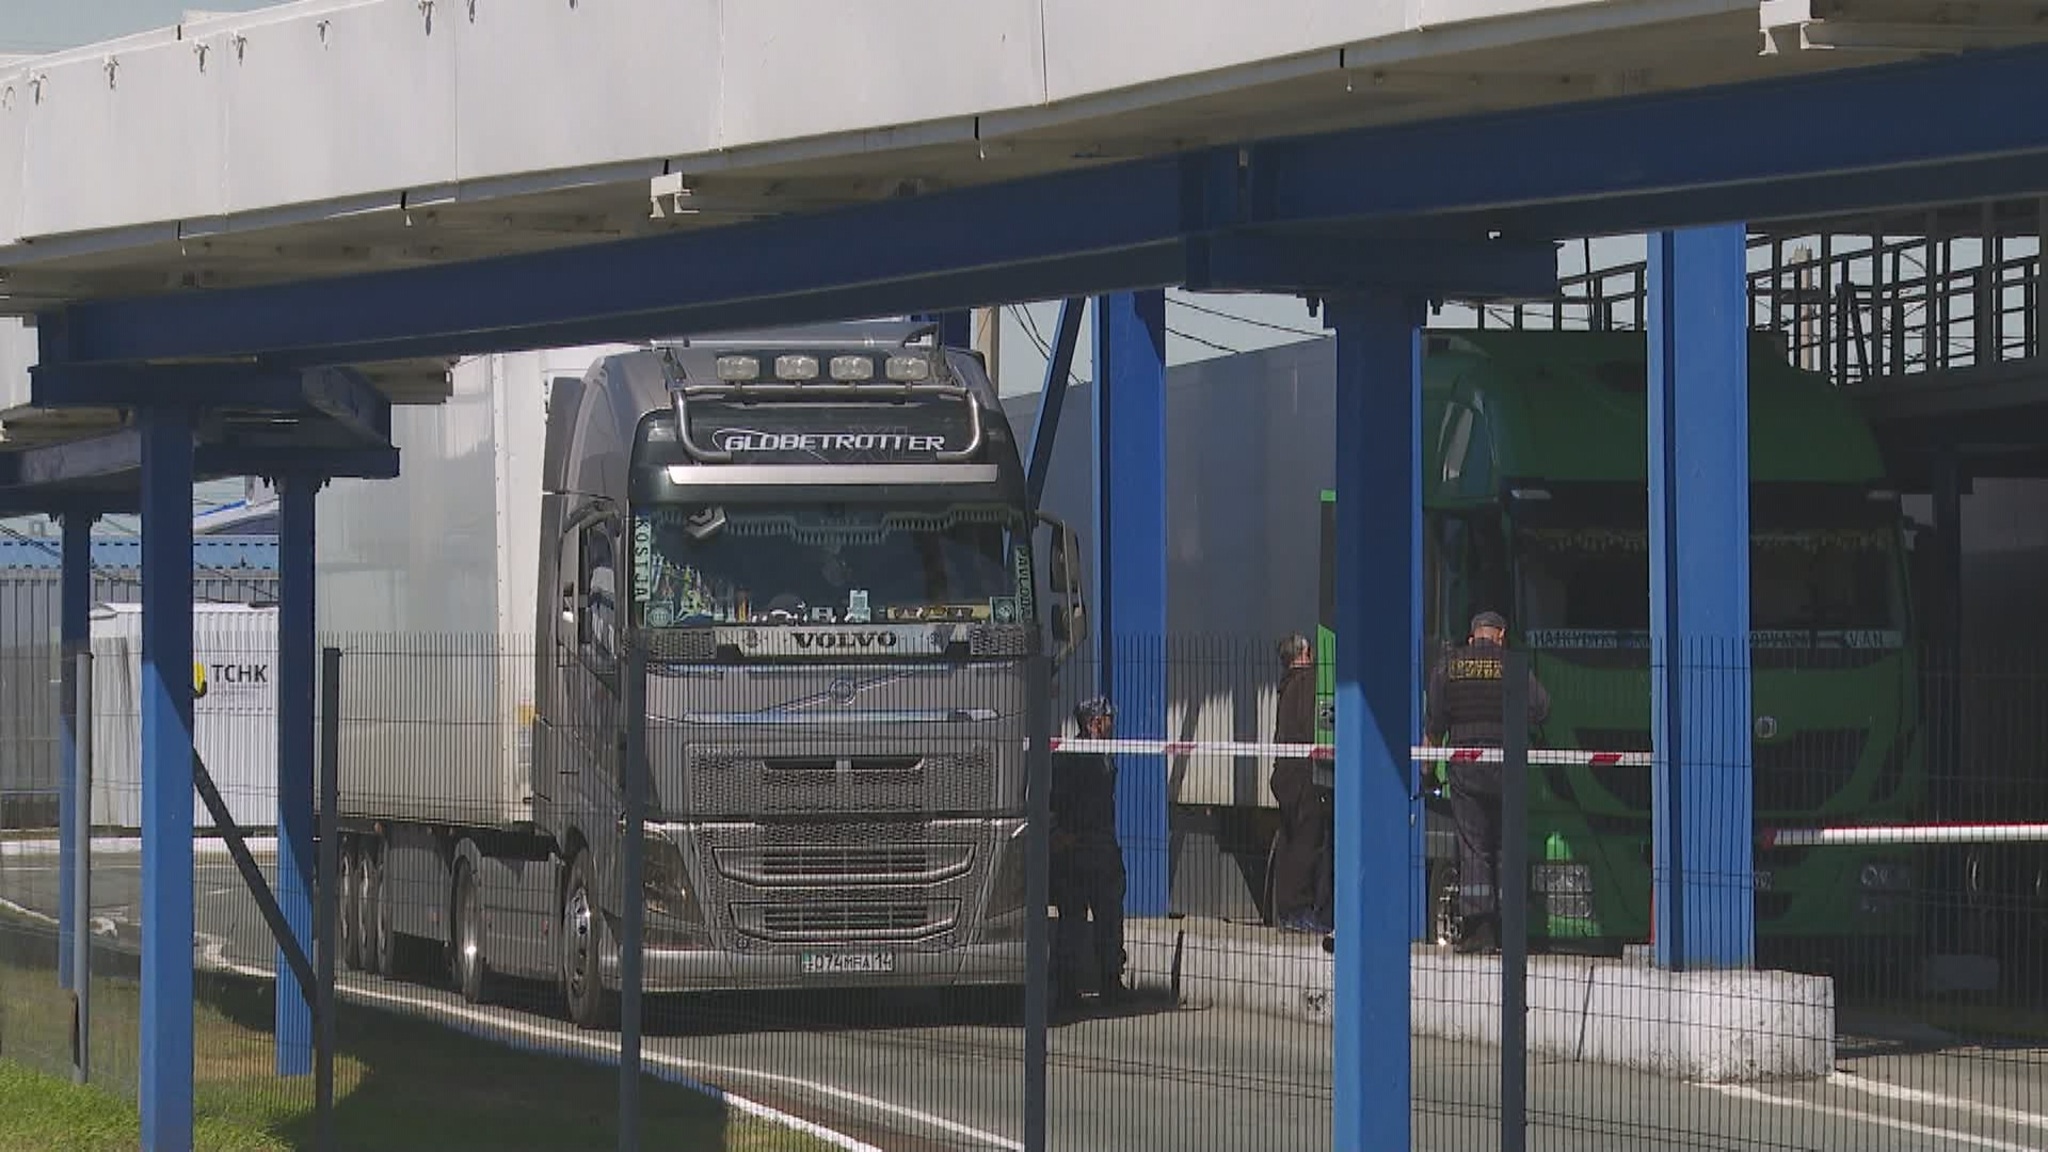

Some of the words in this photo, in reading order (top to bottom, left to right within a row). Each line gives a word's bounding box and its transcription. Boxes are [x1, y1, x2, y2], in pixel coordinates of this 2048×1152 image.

[724, 433, 945, 451] GLOBETROTTER
[790, 632, 897, 649] VOLVO
[211, 664, 268, 683] TCHK
